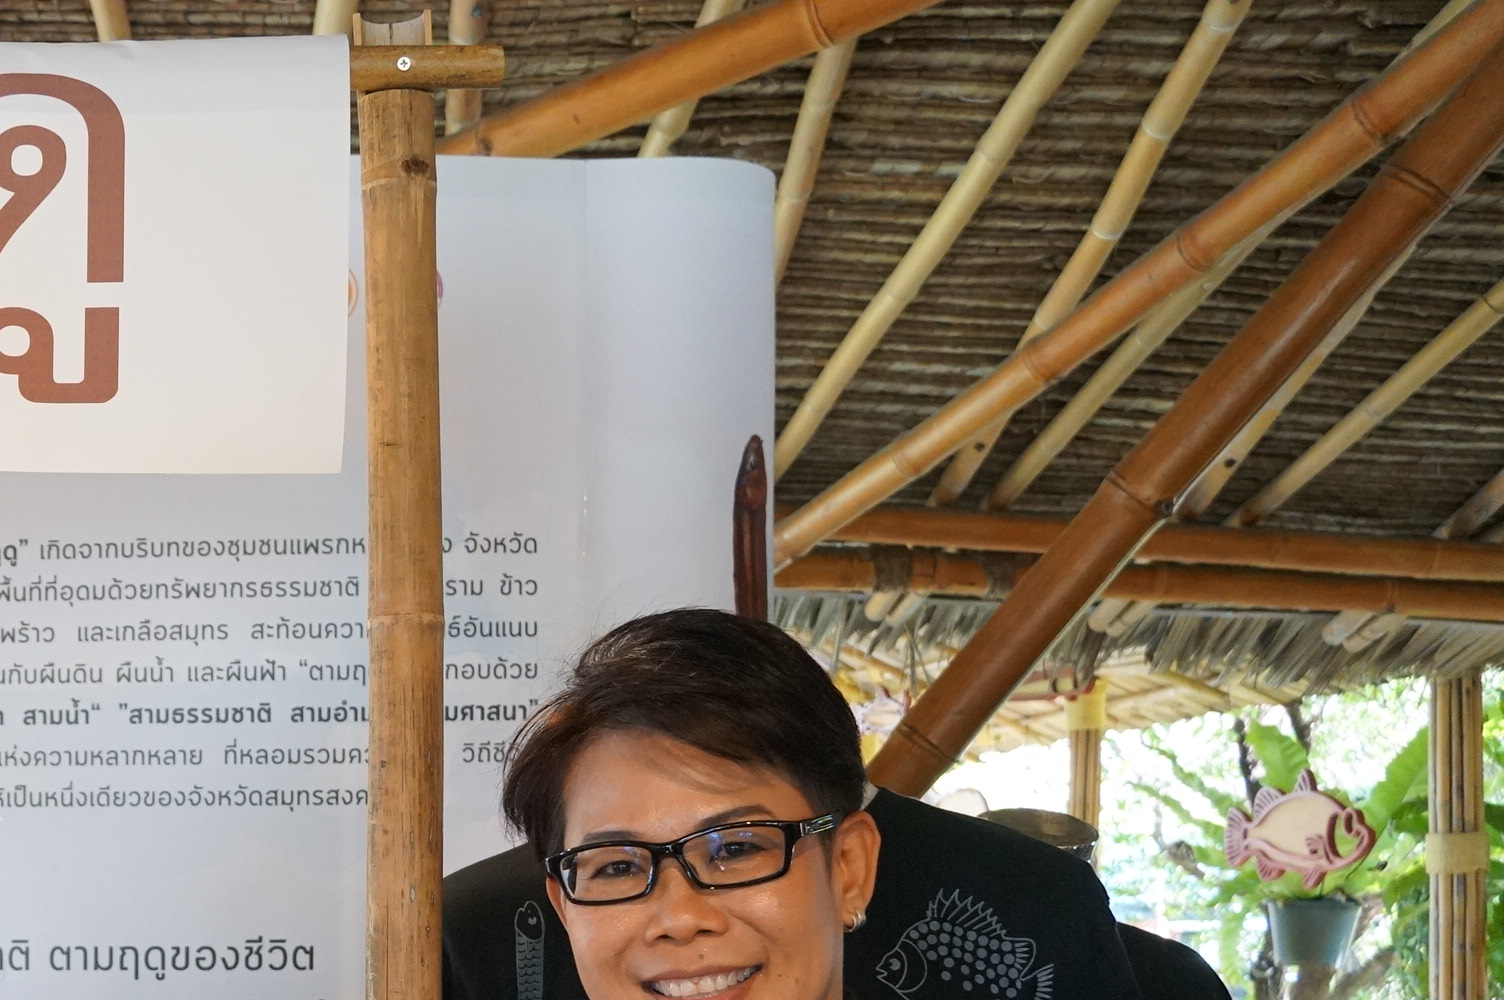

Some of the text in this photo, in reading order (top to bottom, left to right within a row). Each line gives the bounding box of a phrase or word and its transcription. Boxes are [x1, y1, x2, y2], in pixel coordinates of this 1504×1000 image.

[464, 532, 538, 554] จังหวัด
[499, 575, 538, 597] ข้าว
[77, 619, 229, 646] และเกลือสมุทร
[251, 617, 368, 641] สะท้อนควา
[116, 655, 174, 683] ผืนน้ำ
[187, 658, 286, 682] และผืนฟ้า
[49, 935, 314, 981] ตามฤดูของชีวิต
